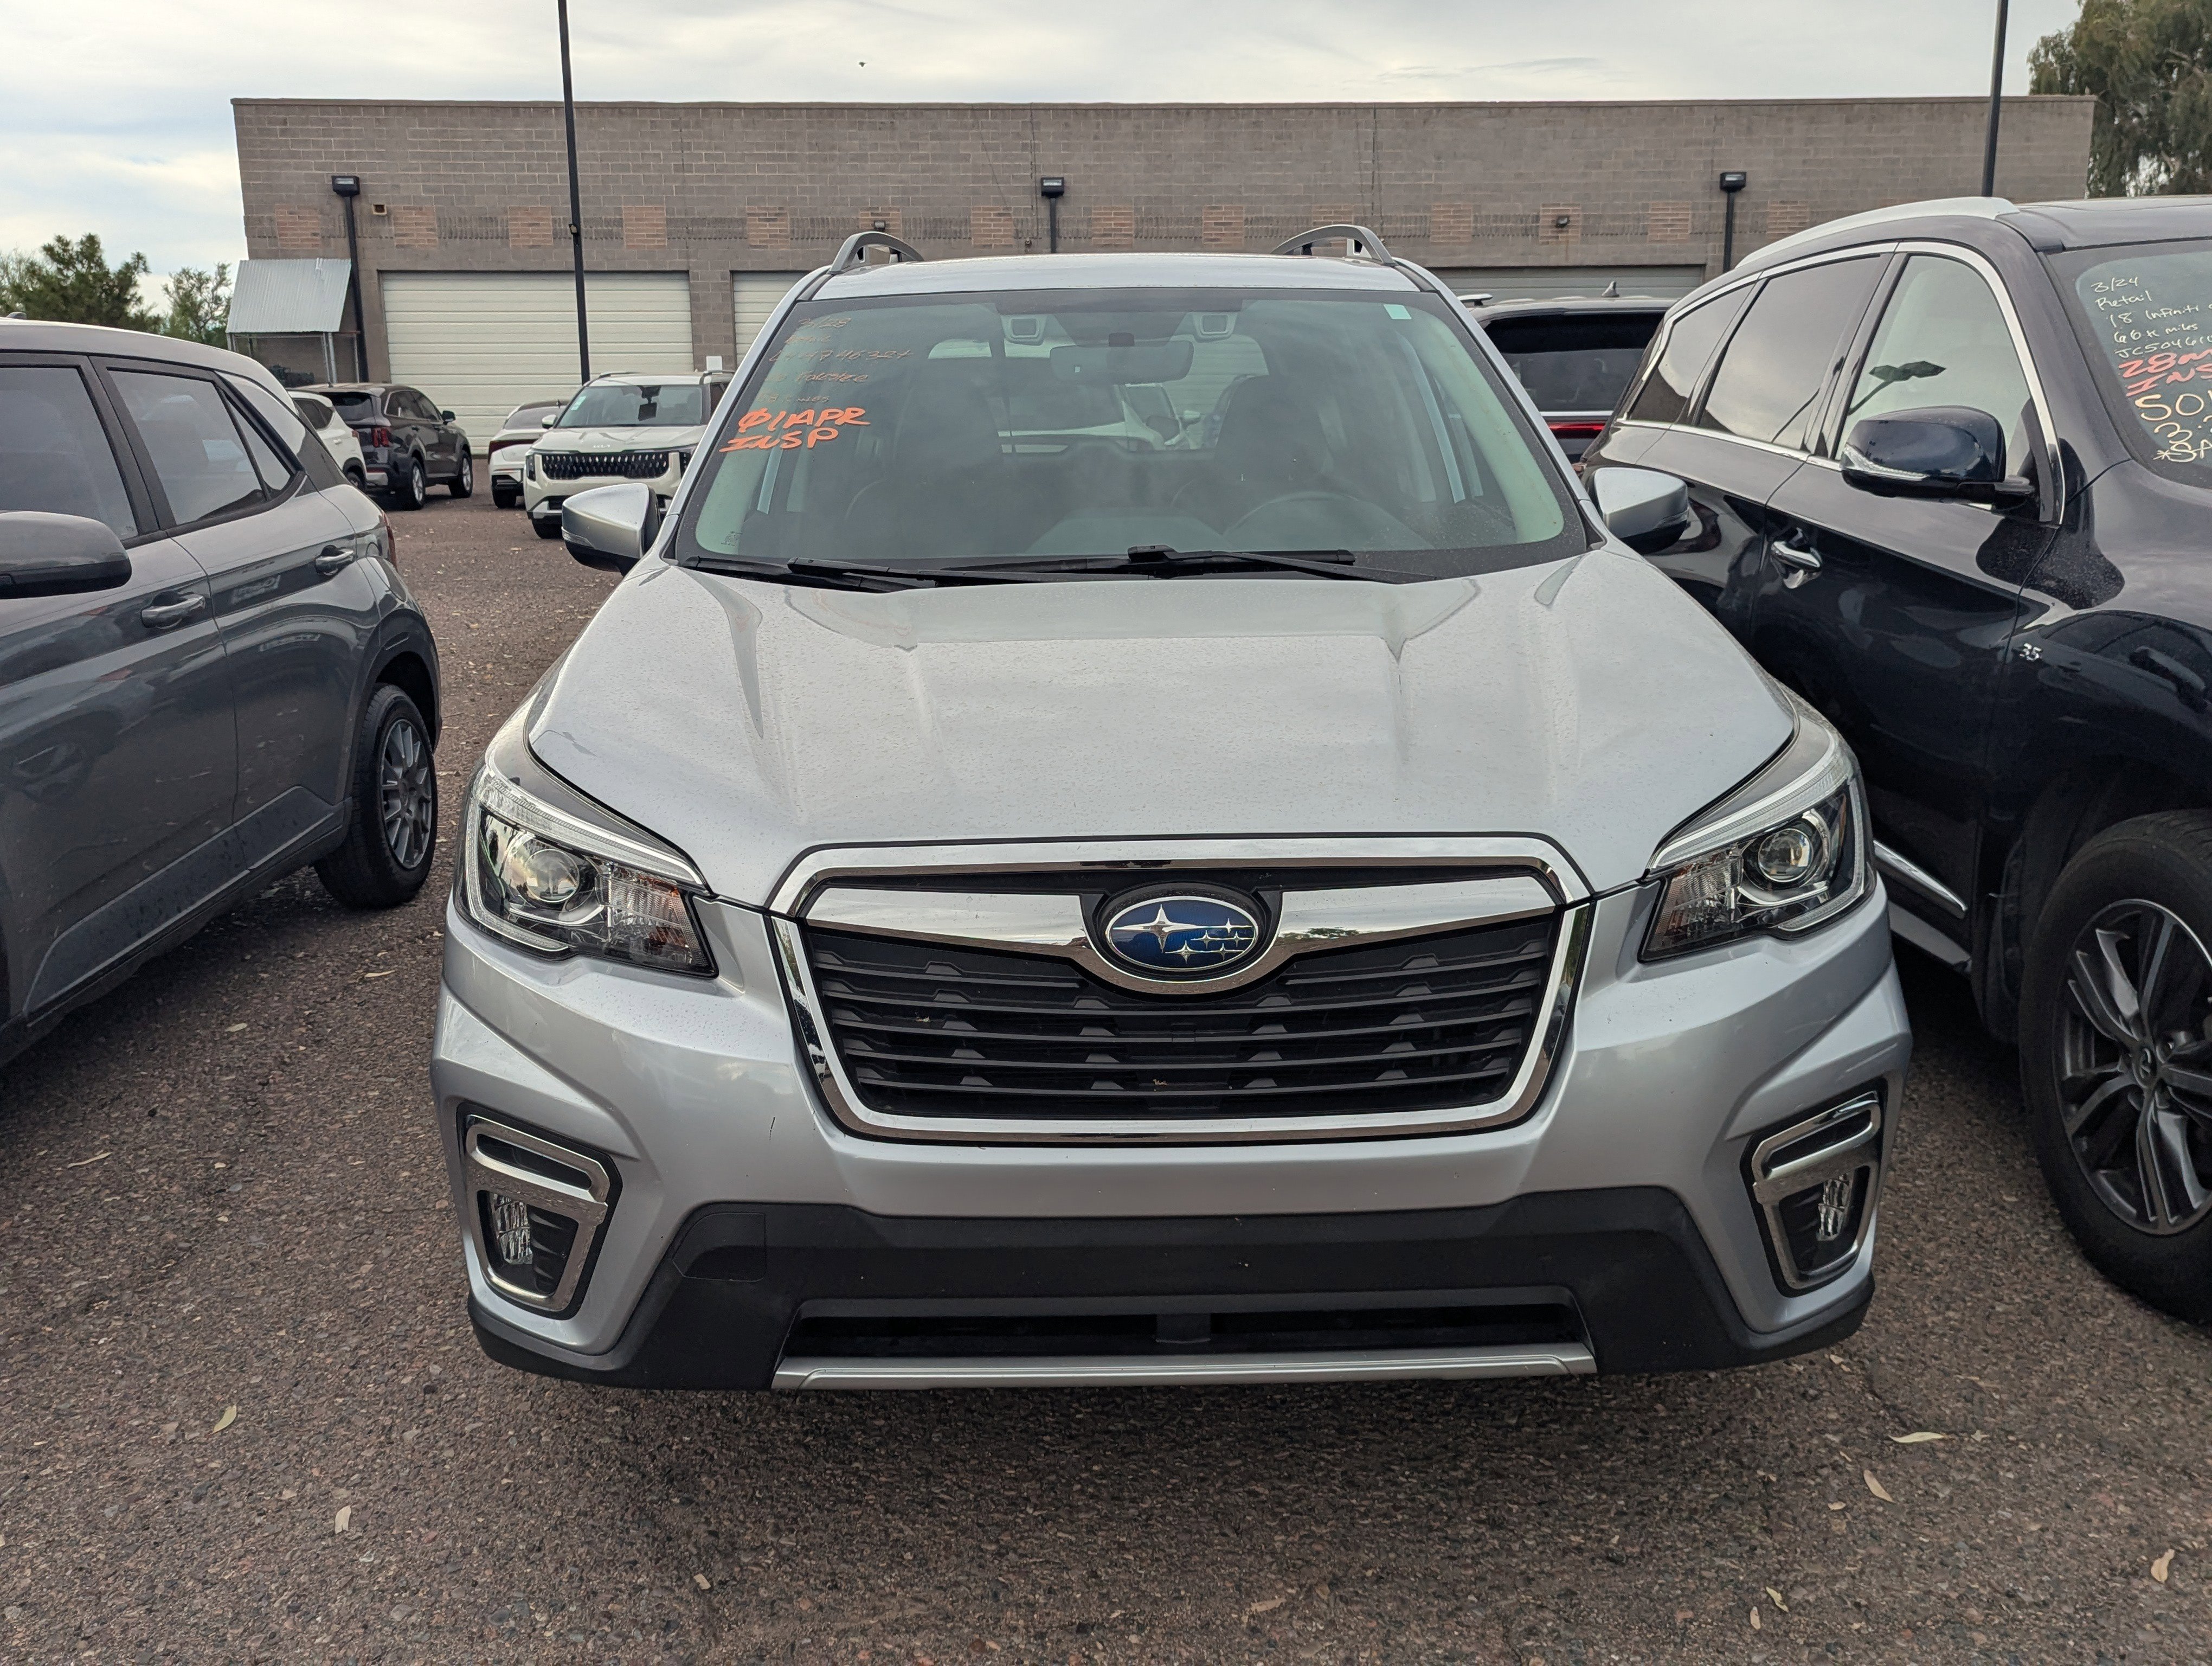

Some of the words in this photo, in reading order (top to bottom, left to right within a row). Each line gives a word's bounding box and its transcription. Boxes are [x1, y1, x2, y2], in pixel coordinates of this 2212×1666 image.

[2091, 276, 2138, 293] 3/24
[2095, 290, 2152, 311] Retail
[2134, 389, 2212, 421] SO
